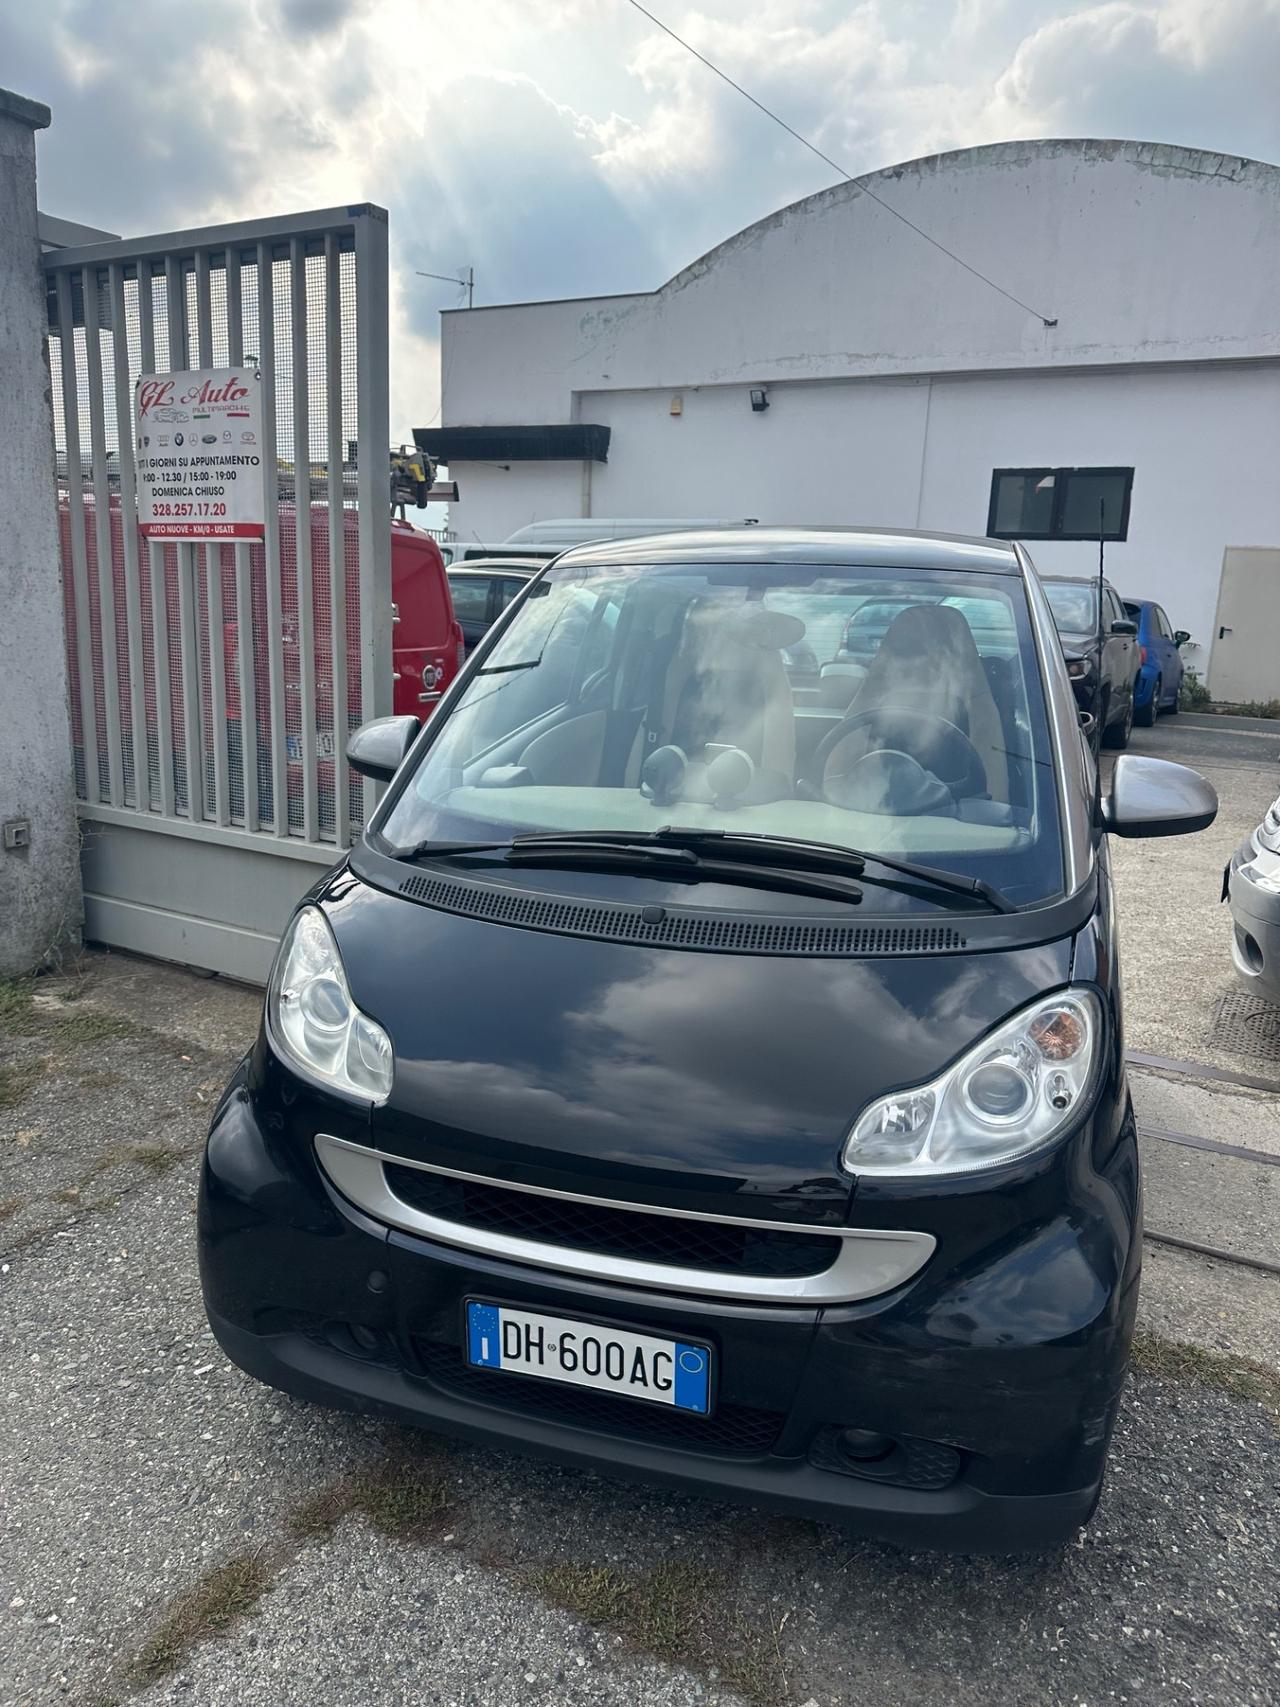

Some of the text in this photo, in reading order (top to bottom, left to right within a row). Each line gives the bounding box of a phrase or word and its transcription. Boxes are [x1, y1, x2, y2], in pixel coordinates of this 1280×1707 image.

[138, 377, 250, 418] GL Auto
[149, 458, 177, 468] GIORNI
[178, 457, 189, 467] SU
[190, 455, 260, 467] APPUNTAMENTO
[162, 472, 182, 482] 12.30
[189, 471, 209, 481] 15:00
[215, 470, 237, 480] 19:00
[152, 486, 225, 497] DOMENICA CHIUSO
[152, 503, 226, 516] 328.257.17.20
[149, 525, 166, 533] AUTO
[167, 525, 189, 533] NUOVE
[214, 525, 235, 534] USATE
[559, 1332, 673, 1391] 600AG
